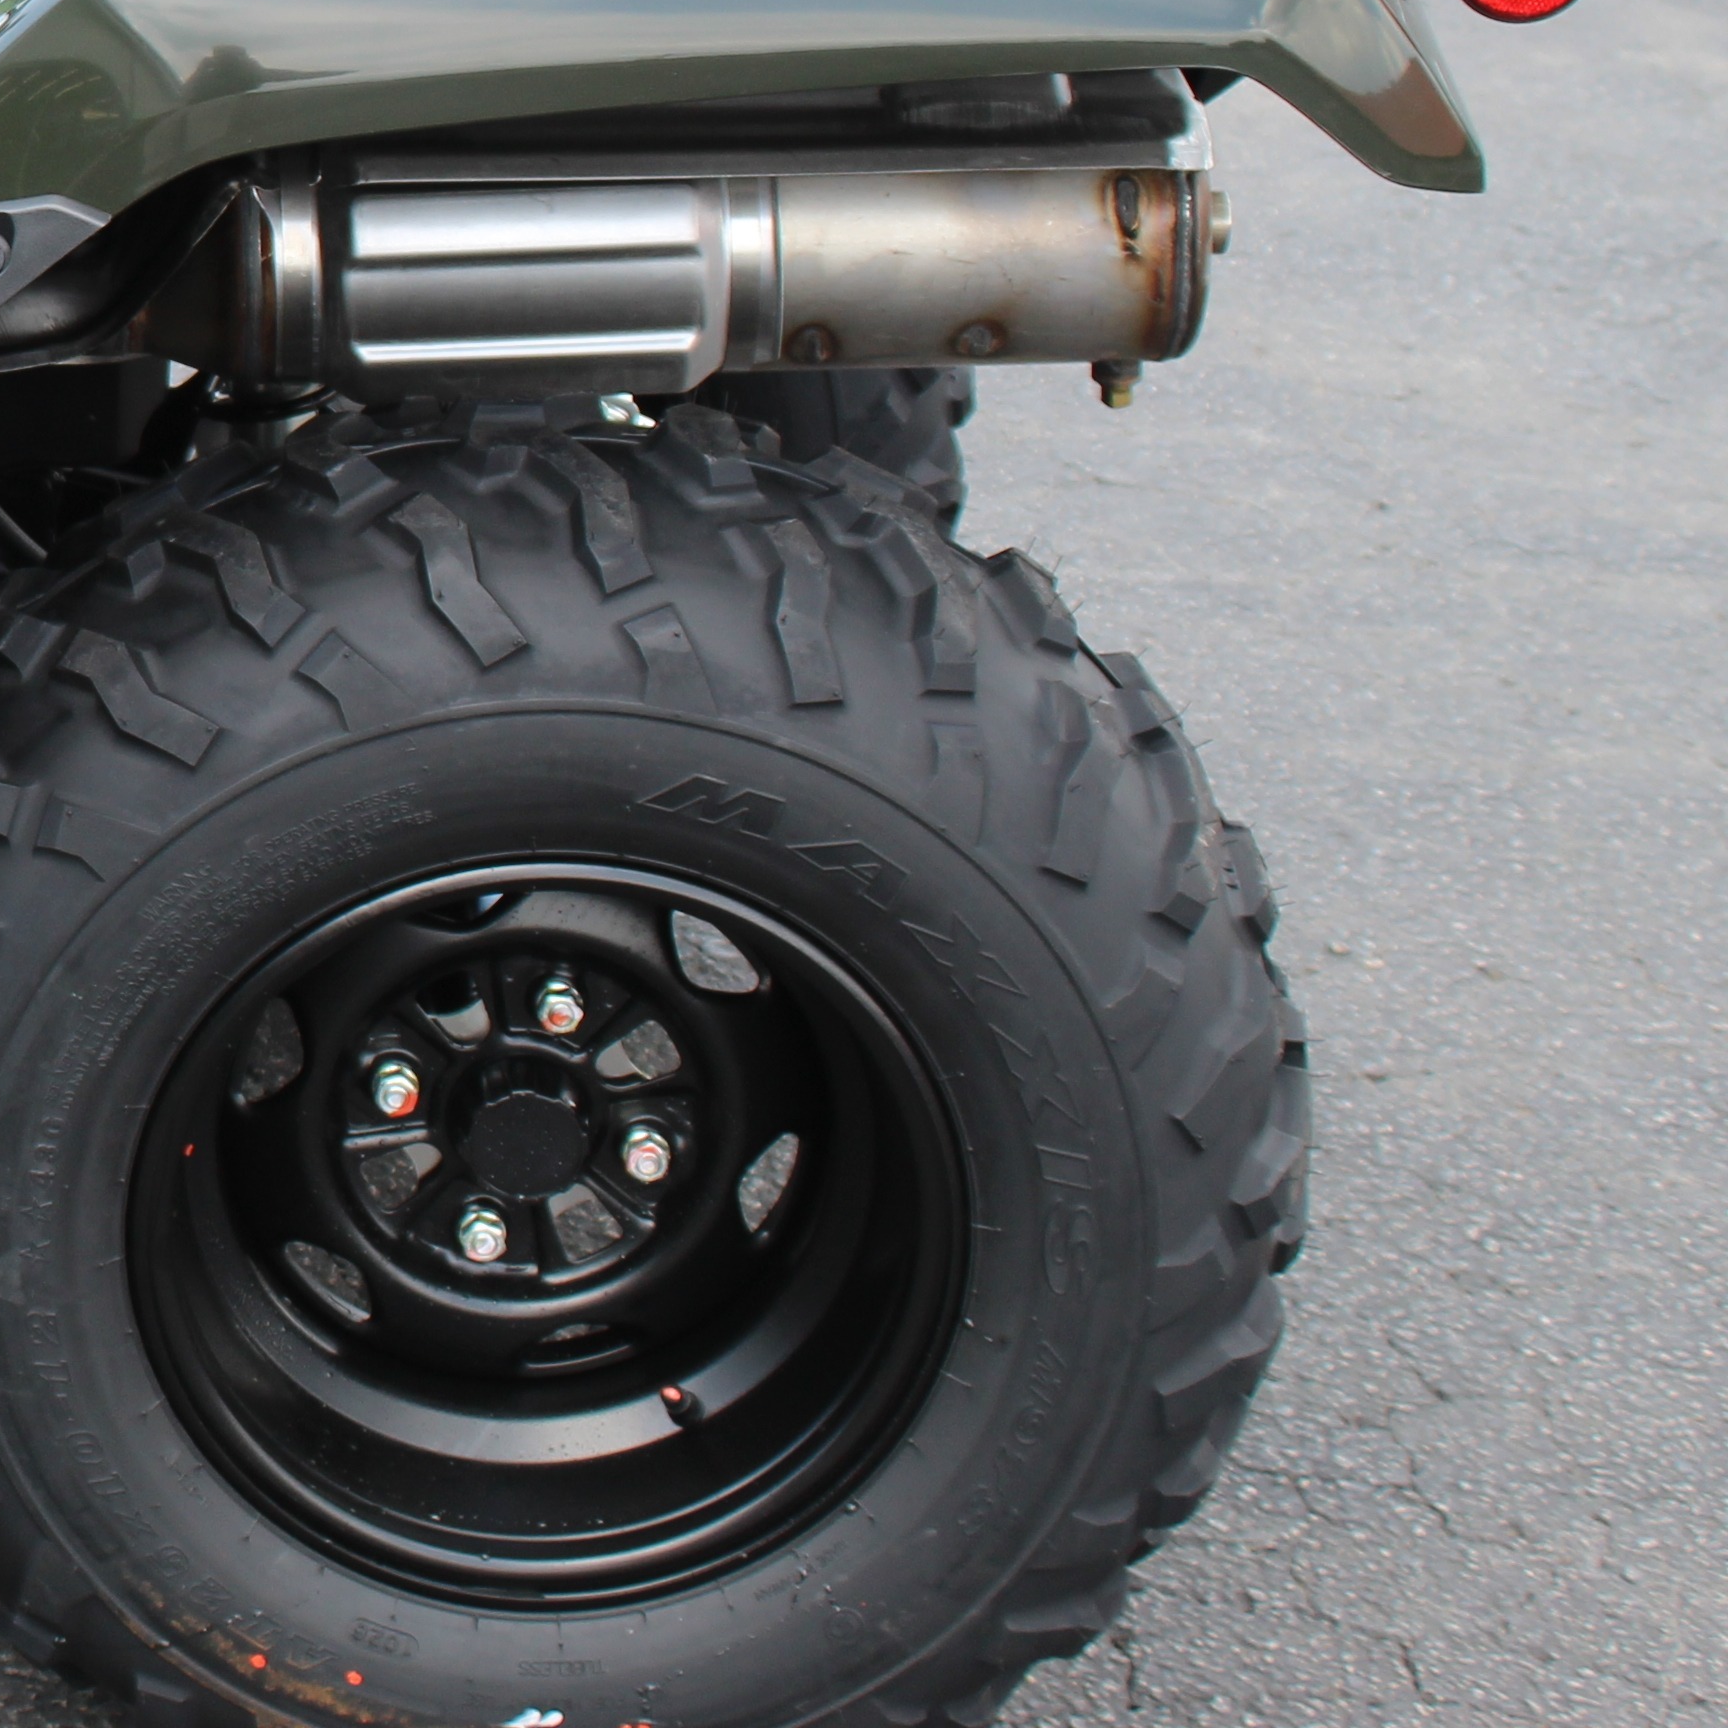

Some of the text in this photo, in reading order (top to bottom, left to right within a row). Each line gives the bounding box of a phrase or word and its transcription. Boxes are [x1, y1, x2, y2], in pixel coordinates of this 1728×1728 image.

[137, 854, 215, 926] WARNING
[635, 771, 1093, 1298] MAXXIS
[516, 1654, 607, 1680] TUBELESS
